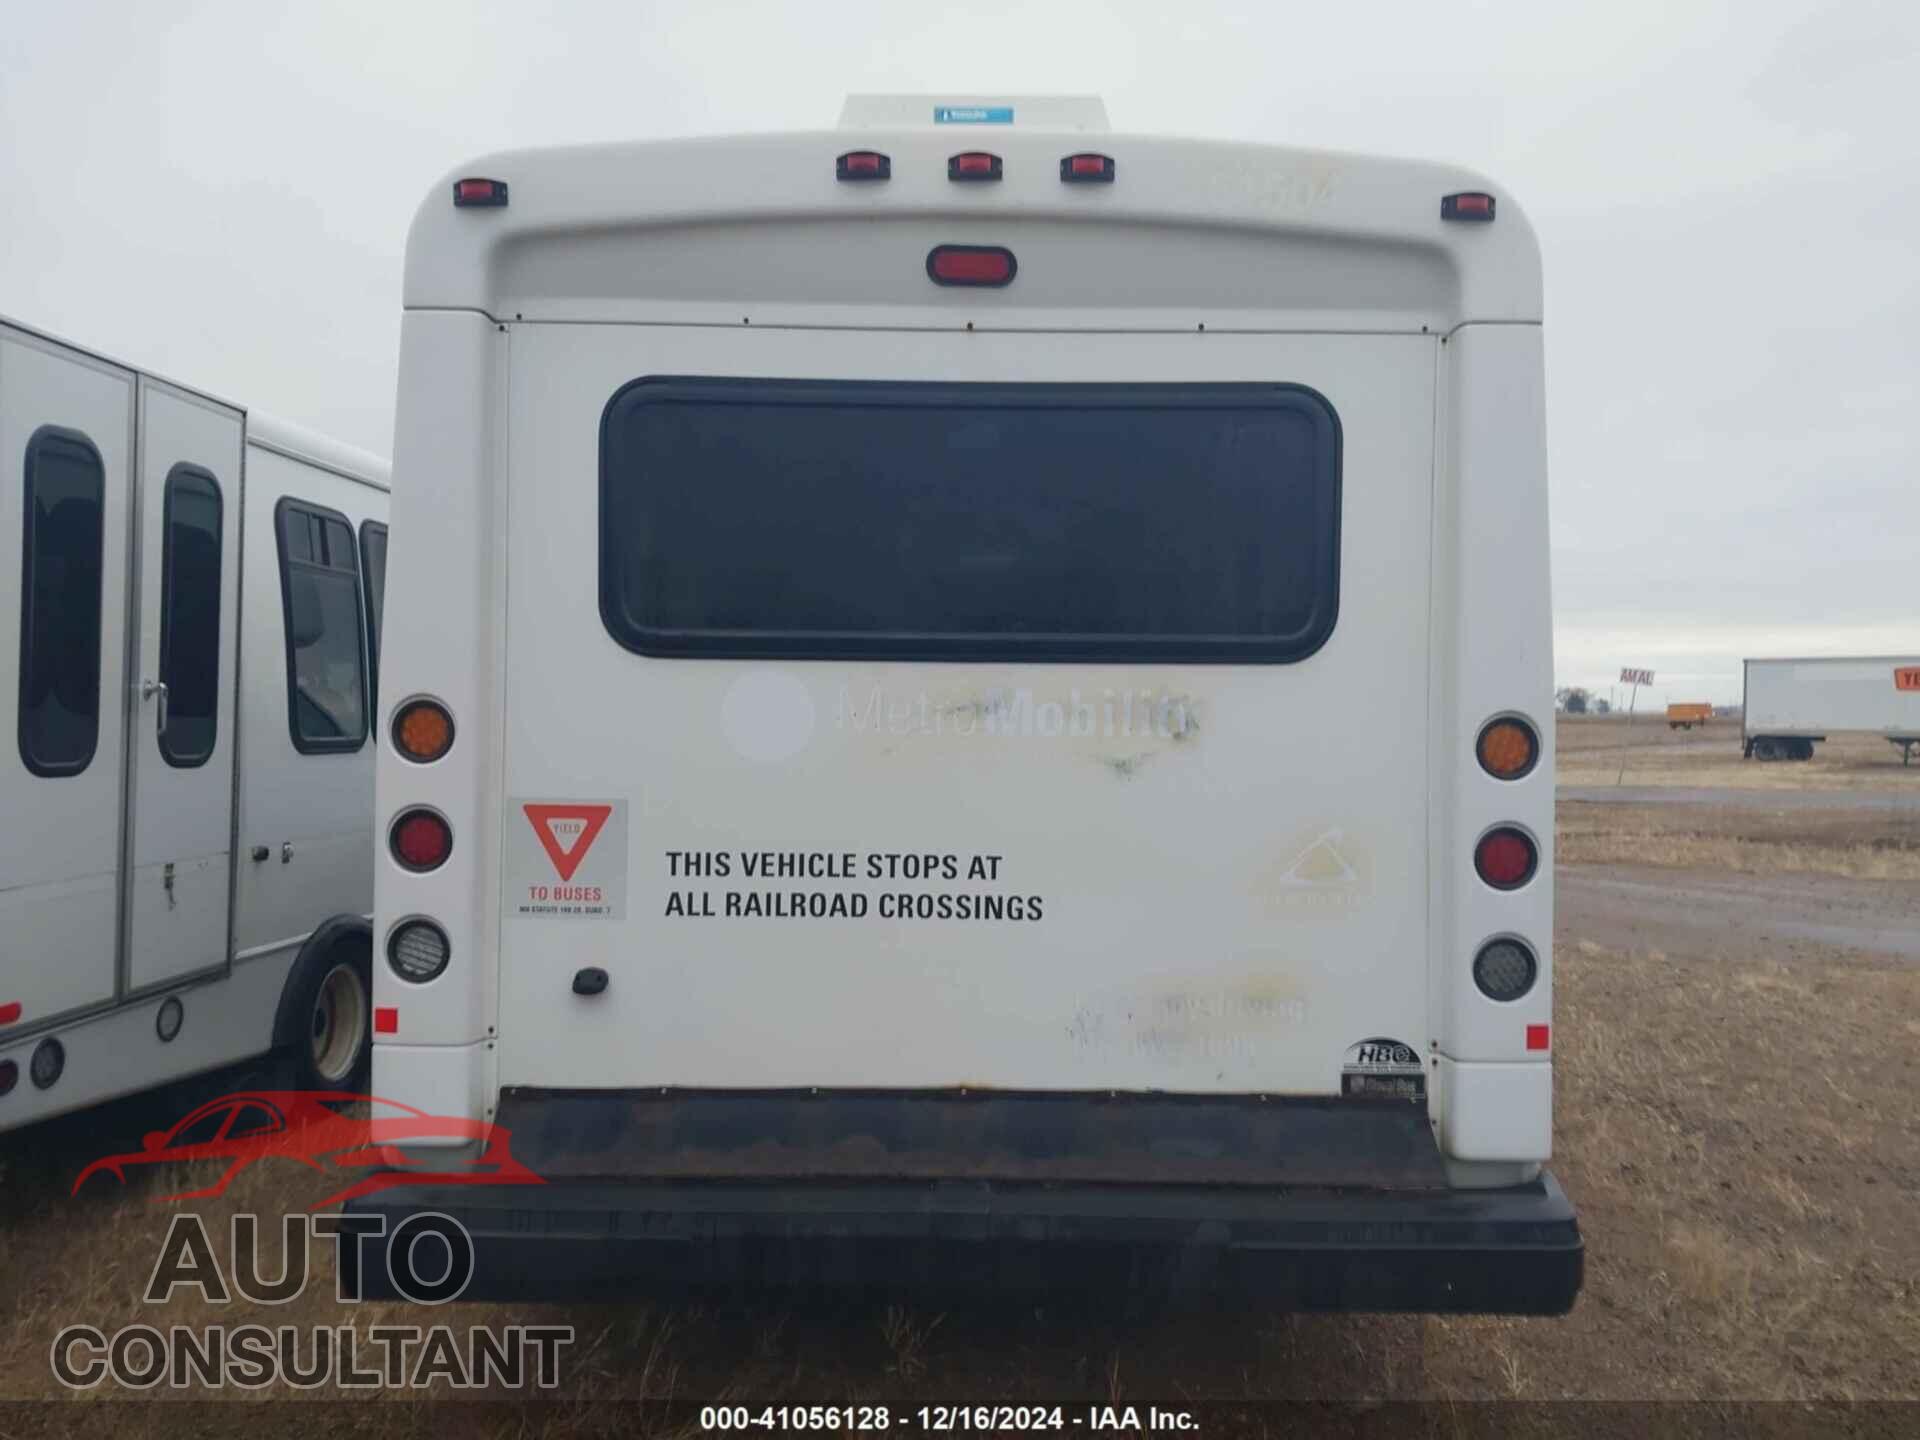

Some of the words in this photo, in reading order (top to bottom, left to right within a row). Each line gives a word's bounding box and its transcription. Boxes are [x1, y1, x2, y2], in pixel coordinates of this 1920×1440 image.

[553, 823, 582, 834] YIELD
[666, 852, 730, 877] THIS
[741, 852, 856, 878] VEHICLE
[867, 854, 957, 880] STOPS
[968, 855, 1003, 880] AT
[529, 886, 548, 901] TO
[554, 886, 602, 902] BUSES
[665, 891, 716, 917] ALL
[725, 892, 868, 918] RAILROAD
[879, 894, 1043, 921] CROSSINGS
